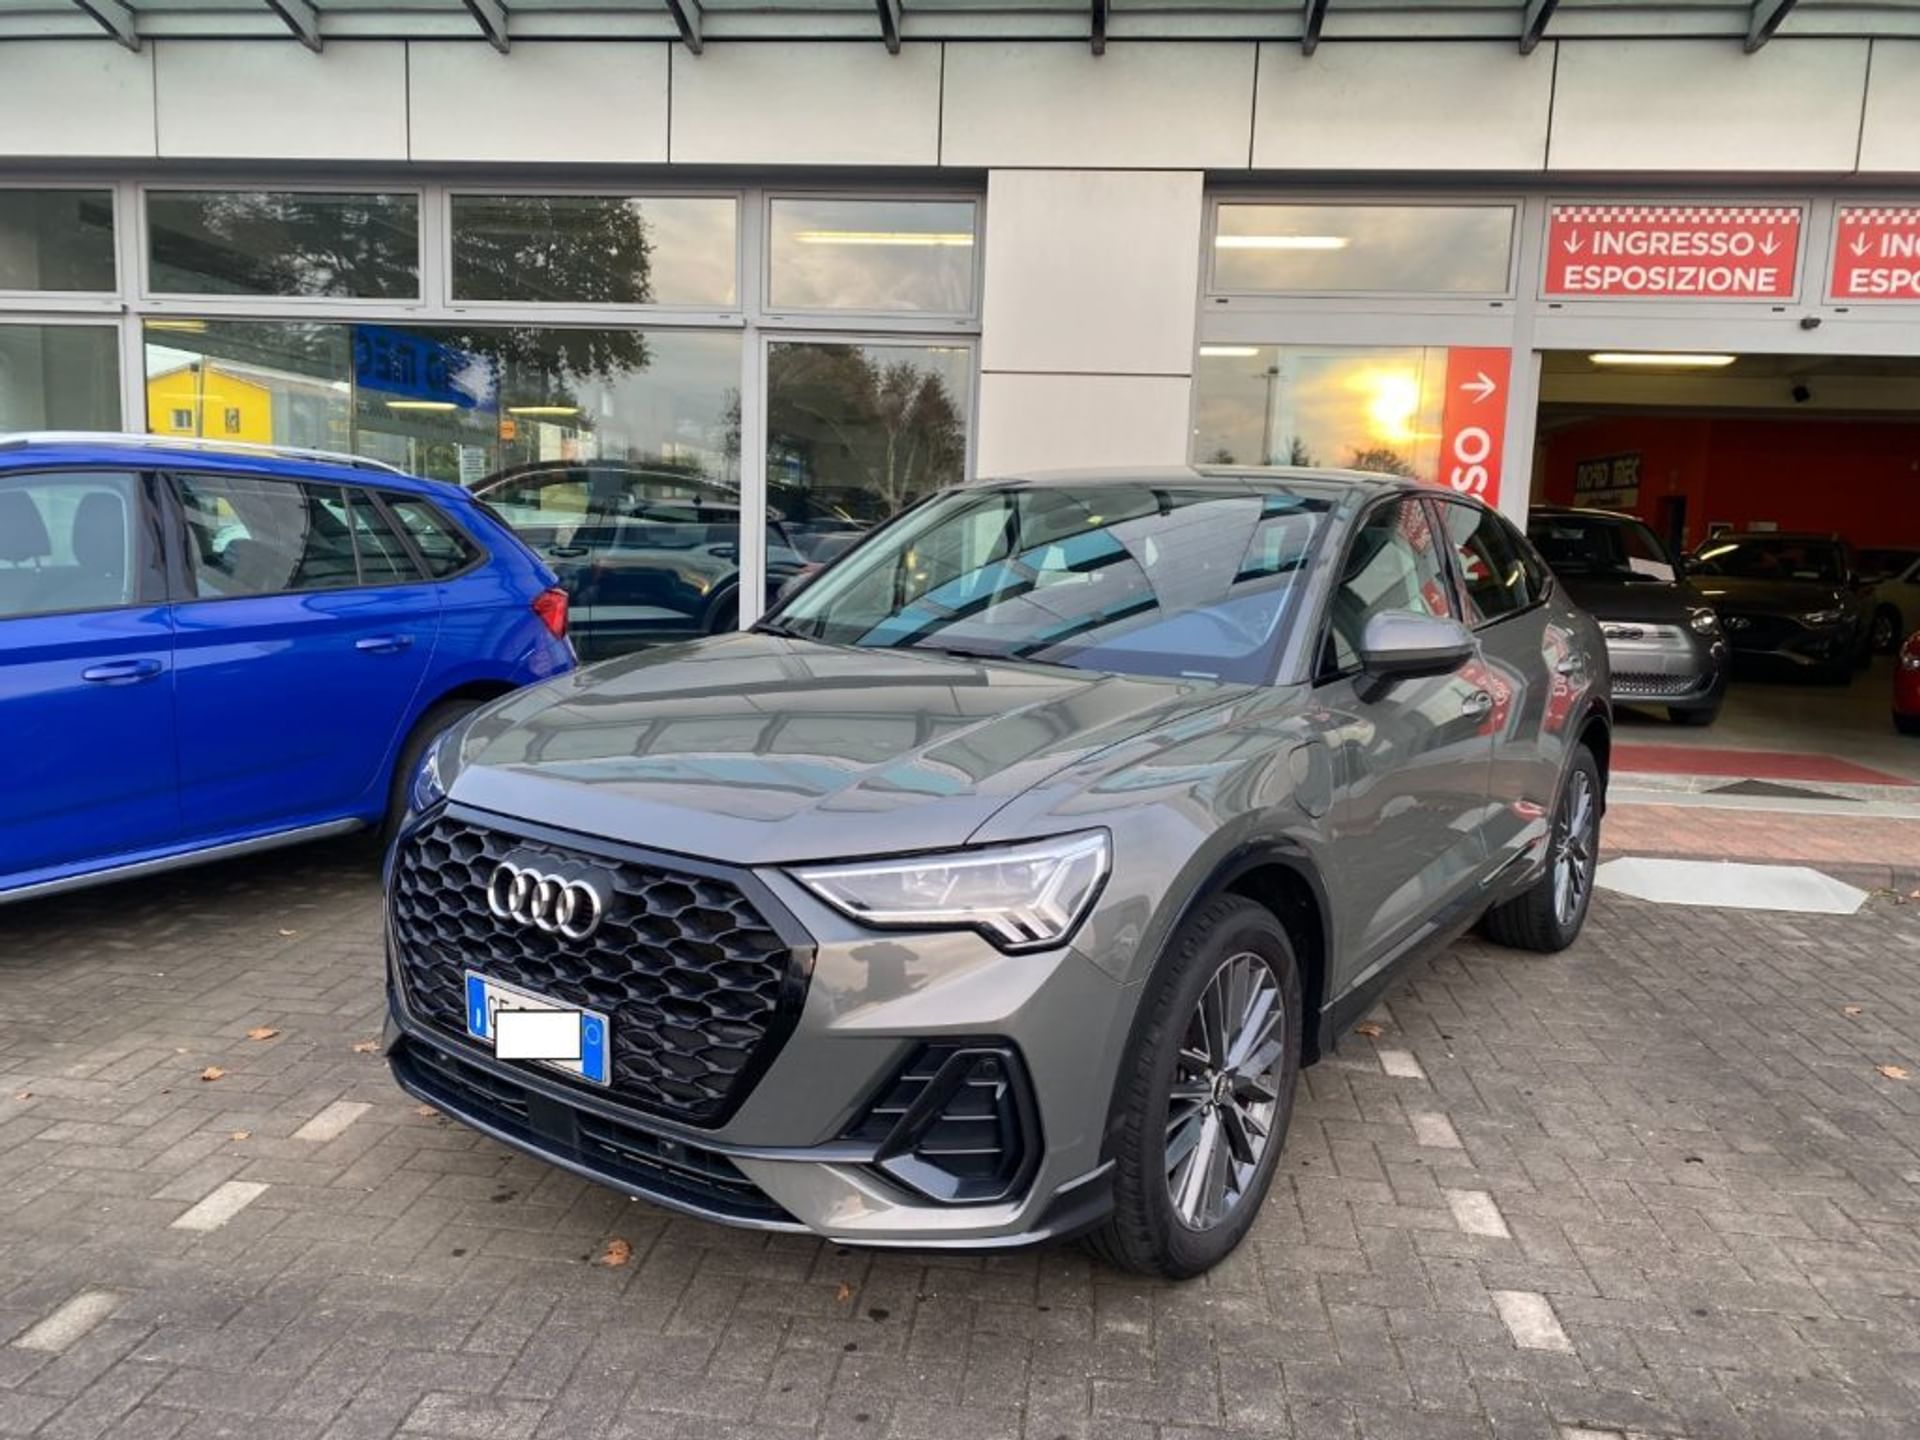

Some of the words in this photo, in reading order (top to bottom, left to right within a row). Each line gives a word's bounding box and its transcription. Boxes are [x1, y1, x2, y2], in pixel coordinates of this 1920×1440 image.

[1592, 230, 1755, 257] INGRESSO
[1881, 232, 1920, 258] IN
[1563, 265, 1778, 292] ESPOSIZIONE
[1451, 427, 1490, 503] SO
